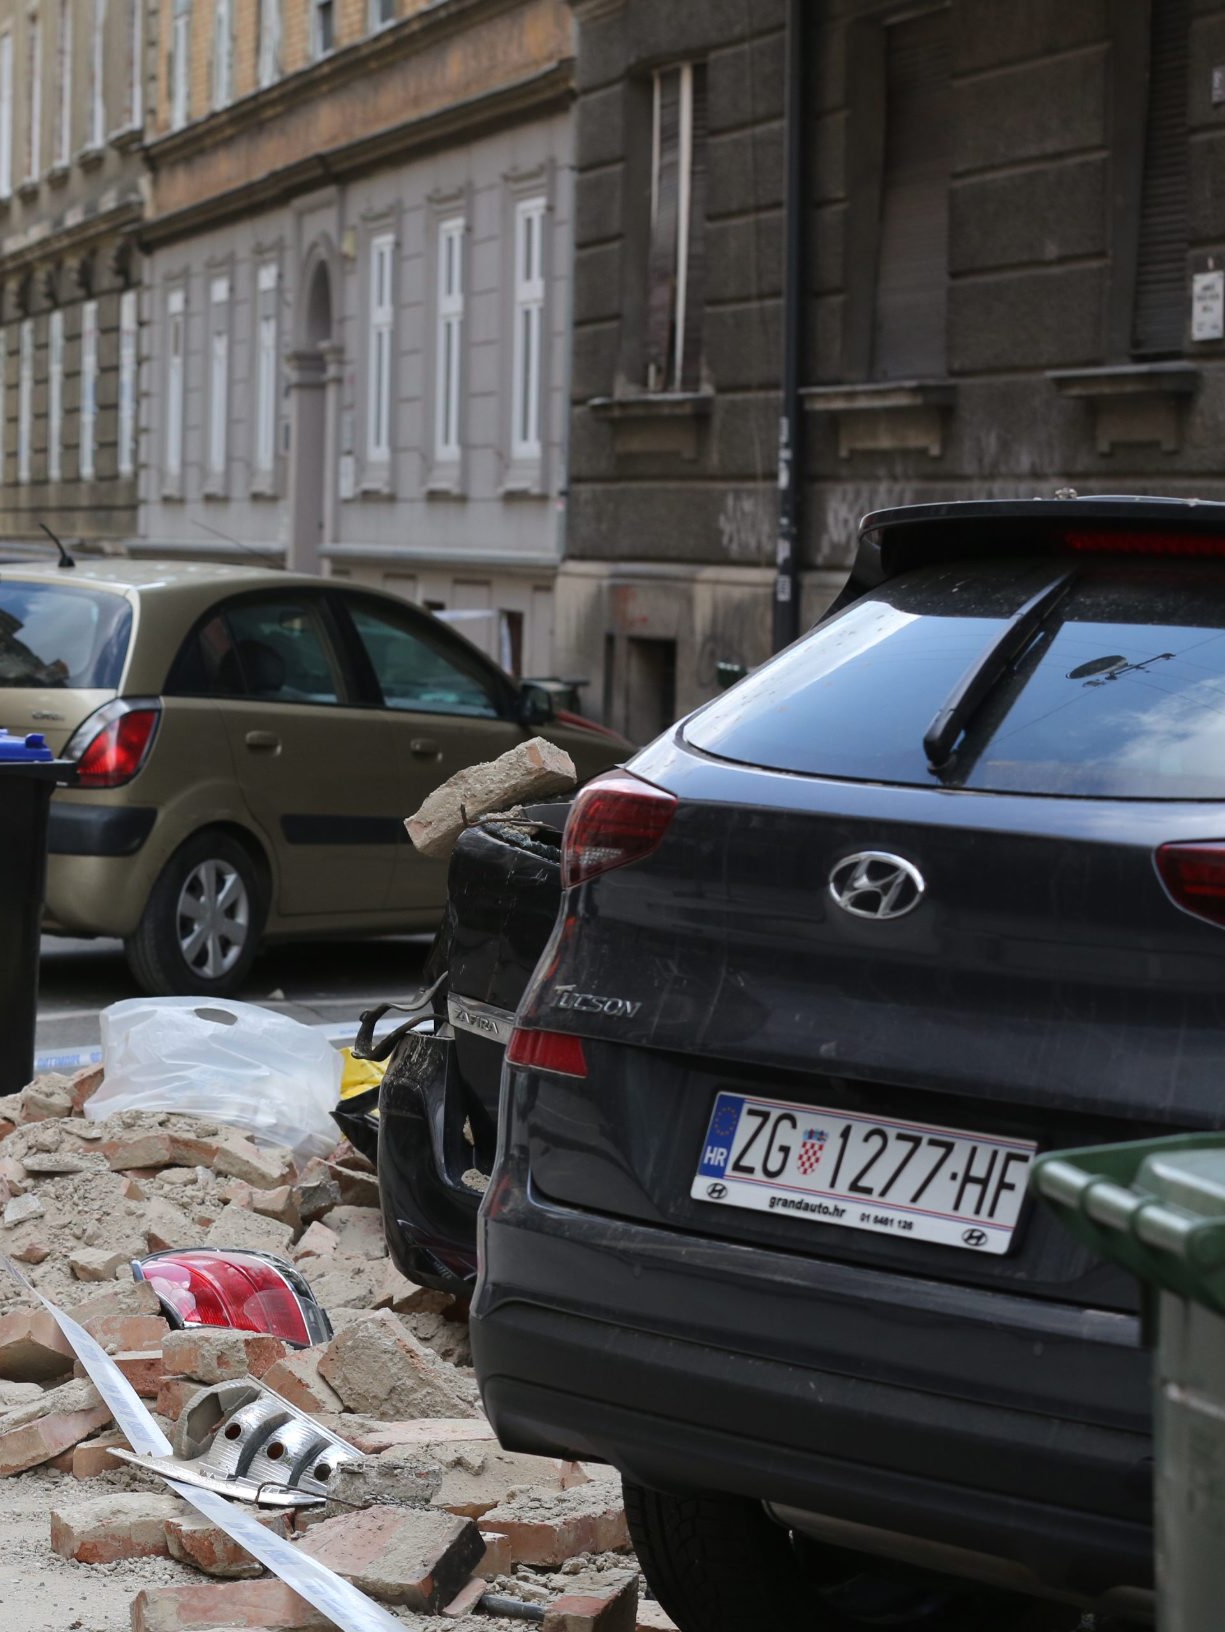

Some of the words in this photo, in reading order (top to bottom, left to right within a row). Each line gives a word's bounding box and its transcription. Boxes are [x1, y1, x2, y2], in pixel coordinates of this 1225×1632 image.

[552, 984, 642, 1018] TUCSON
[454, 1008, 499, 1035] ZAFIRA
[703, 1145, 728, 1168] HR
[731, 1107, 798, 1179] ZG
[769, 1196, 846, 1218] grandauto.hr
